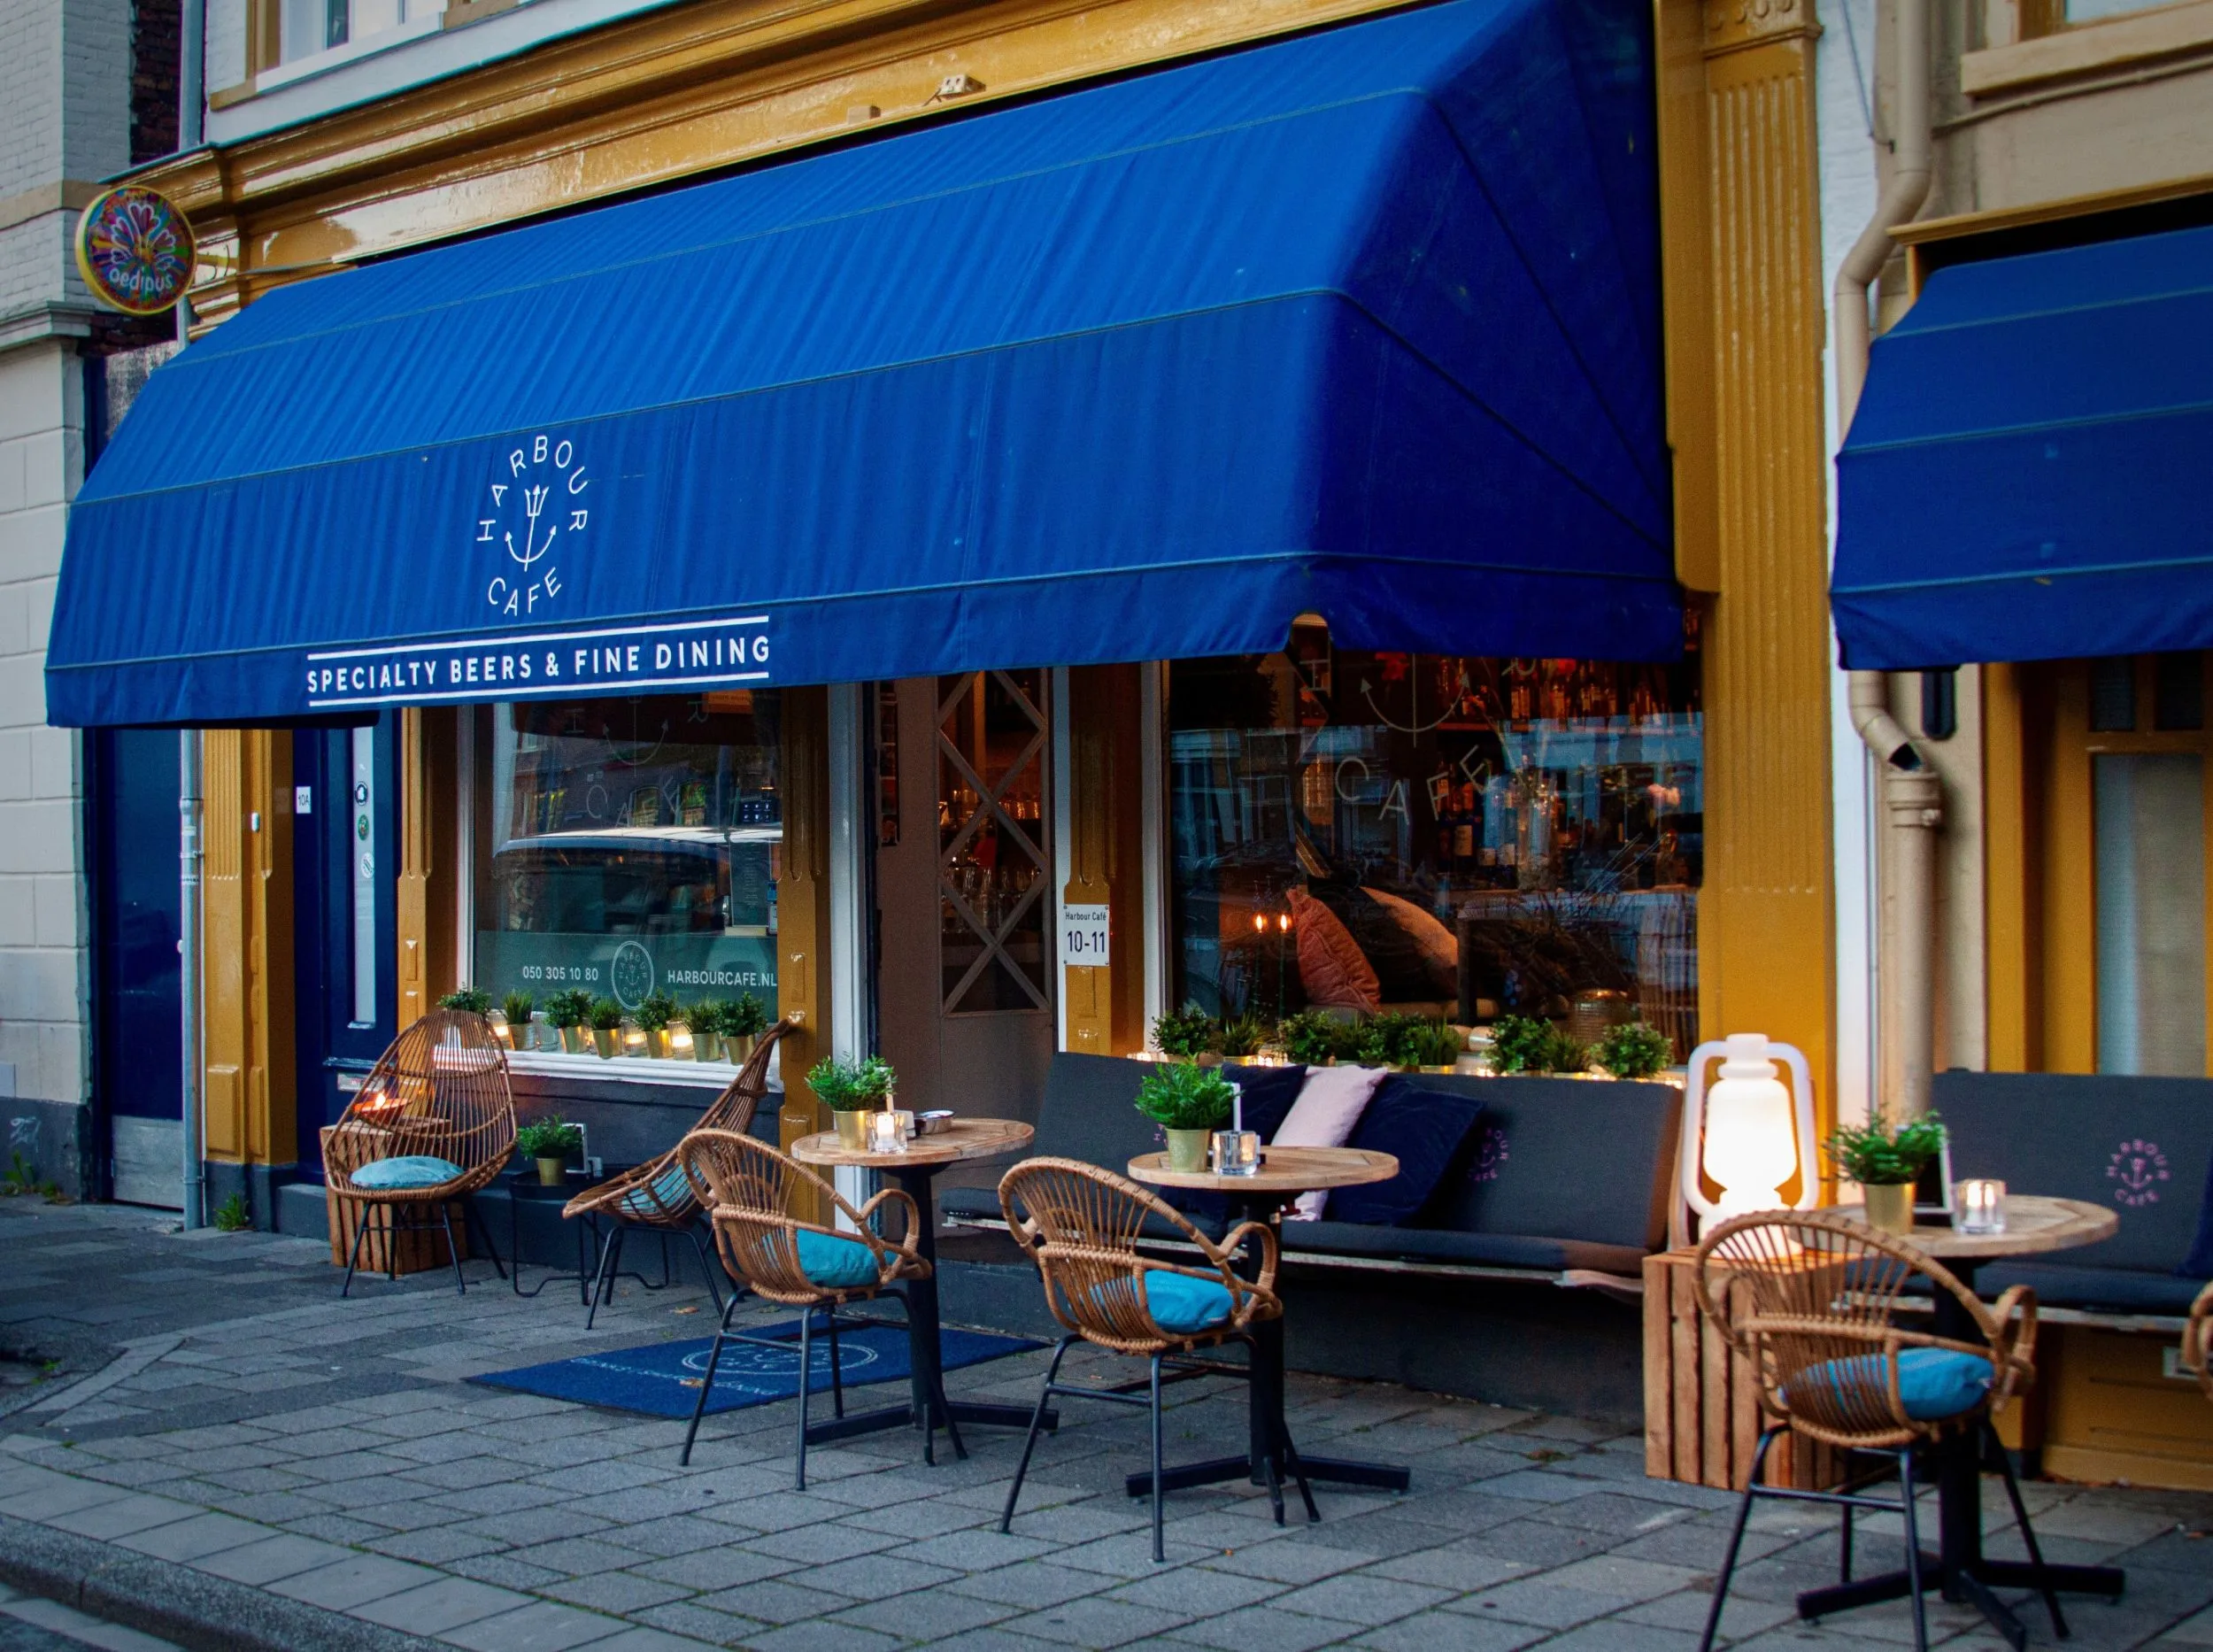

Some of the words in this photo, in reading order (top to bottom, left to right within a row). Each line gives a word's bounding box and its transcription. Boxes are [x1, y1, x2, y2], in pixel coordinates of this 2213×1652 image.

[109, 266, 173, 295] oedipus
[476, 436, 588, 541] HARBOUR
[488, 567, 562, 616] CAFE
[308, 660, 436, 693] SPECIALTY
[450, 653, 531, 683] BEERS
[545, 652, 559, 676] &
[574, 645, 640, 675] FINE
[656, 636, 769, 669] DINING
[1336, 745, 1491, 825] CAFE
[1065, 912, 1091, 921] Harbour
[1091, 911, 1106, 921] Café
[1068, 930, 1105, 953] 10-11
[522, 966, 542, 980] 050
[545, 967, 566, 981] 305
[569, 967, 581, 981] 10
[585, 968, 598, 981] 80
[667, 970, 777, 987] HARBOURCAFE.NL
